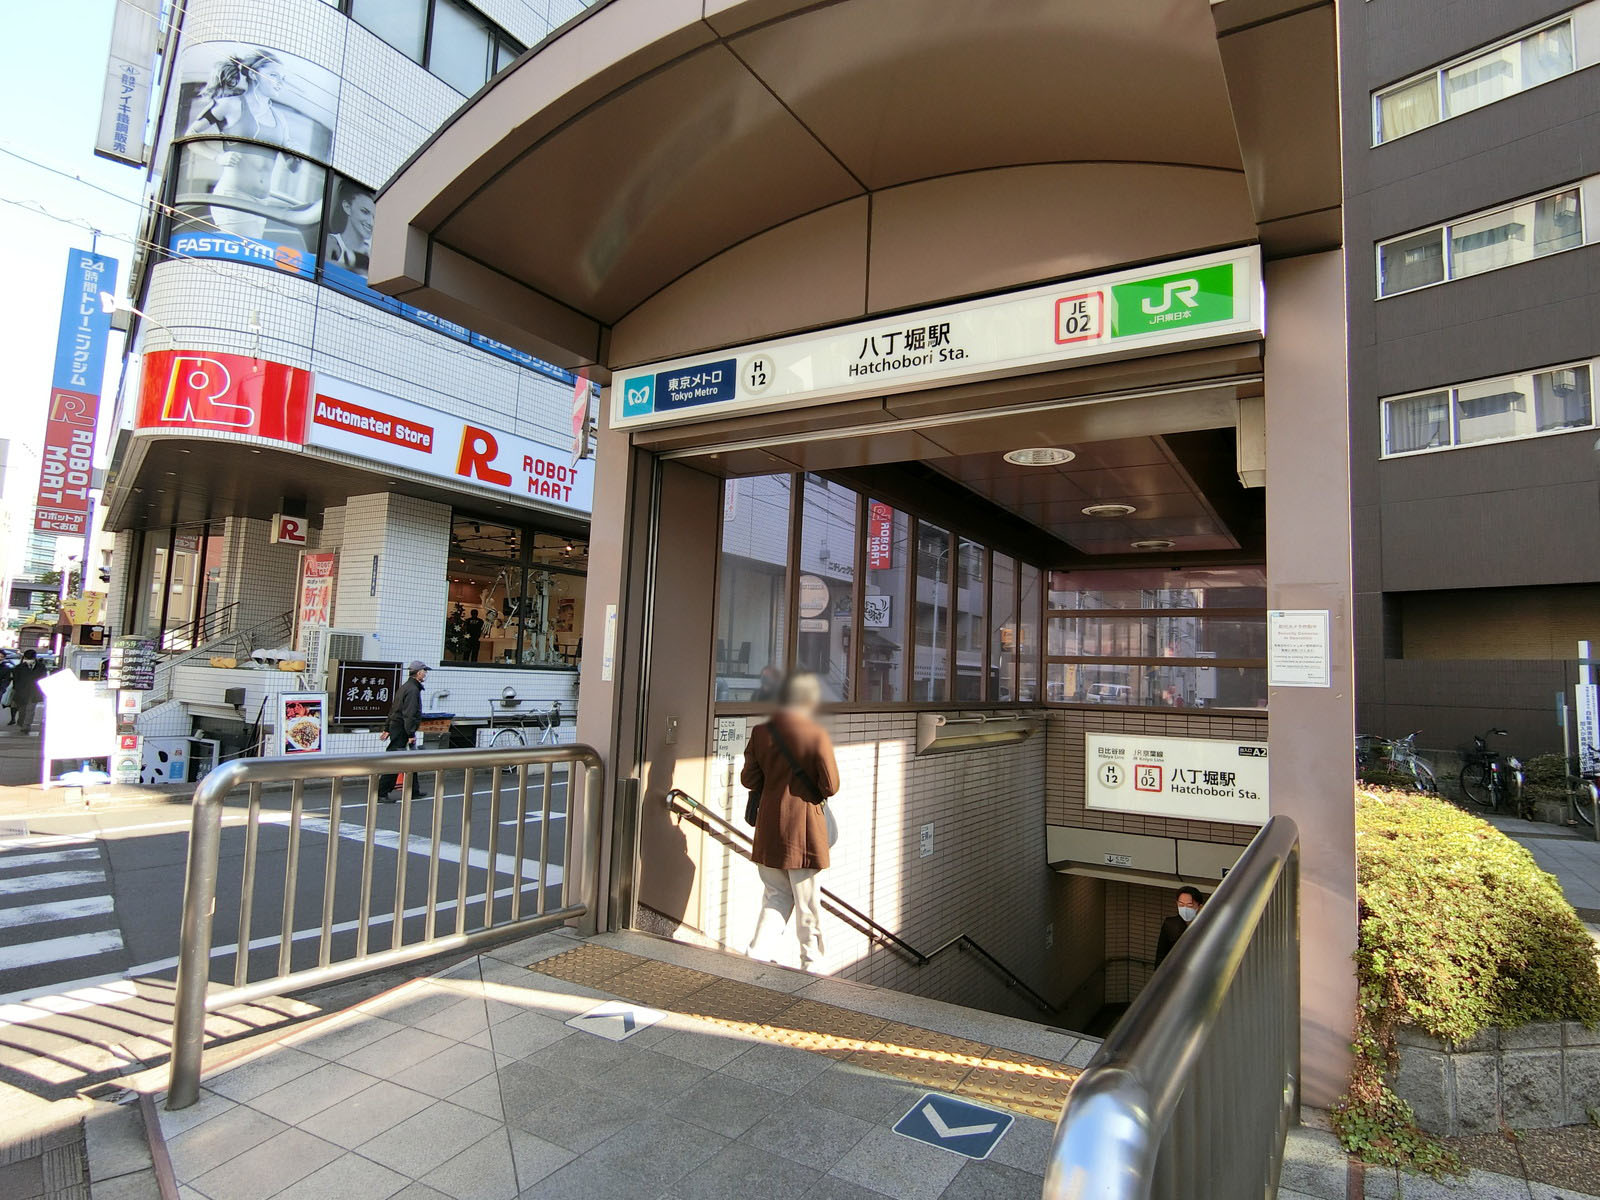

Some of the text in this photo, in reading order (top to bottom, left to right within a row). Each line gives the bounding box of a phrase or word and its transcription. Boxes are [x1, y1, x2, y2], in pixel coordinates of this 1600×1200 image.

[1142, 278, 1199, 314] JR
[1071, 301, 1087, 315] JE
[1149, 310, 1192, 325] JR東日本
[71, 257, 105, 386] 24時間トレーニングジム
[1066, 315, 1091, 334] 02
[859, 322, 950, 359] 八丁堀駅
[754, 361, 763, 372] H
[849, 347, 969, 377] Hatchobori Sta.
[668, 371, 722, 392] 東京メトロ
[751, 373, 766, 387] 12
[671, 386, 718, 402] Tokyo Metro
[317, 402, 431, 447] Automated Store
[66, 429, 93, 500] ROBOT
[523, 455, 578, 485] ROBOT
[41, 446, 68, 503] MART
[528, 476, 572, 502] MART
[880, 522, 889, 558] ROBOT
[871, 537, 880, 566] MART
[1098, 747, 1125, 755] 日比谷線
[1253, 748, 1267, 756] A2
[1105, 774, 1118, 784] 12
[1107, 766, 1115, 774] H
[1171, 768, 1236, 787] 八丁堀駅
[1140, 776, 1156, 787] 02
[1171, 784, 1261, 800] Hatchobori Sta.
